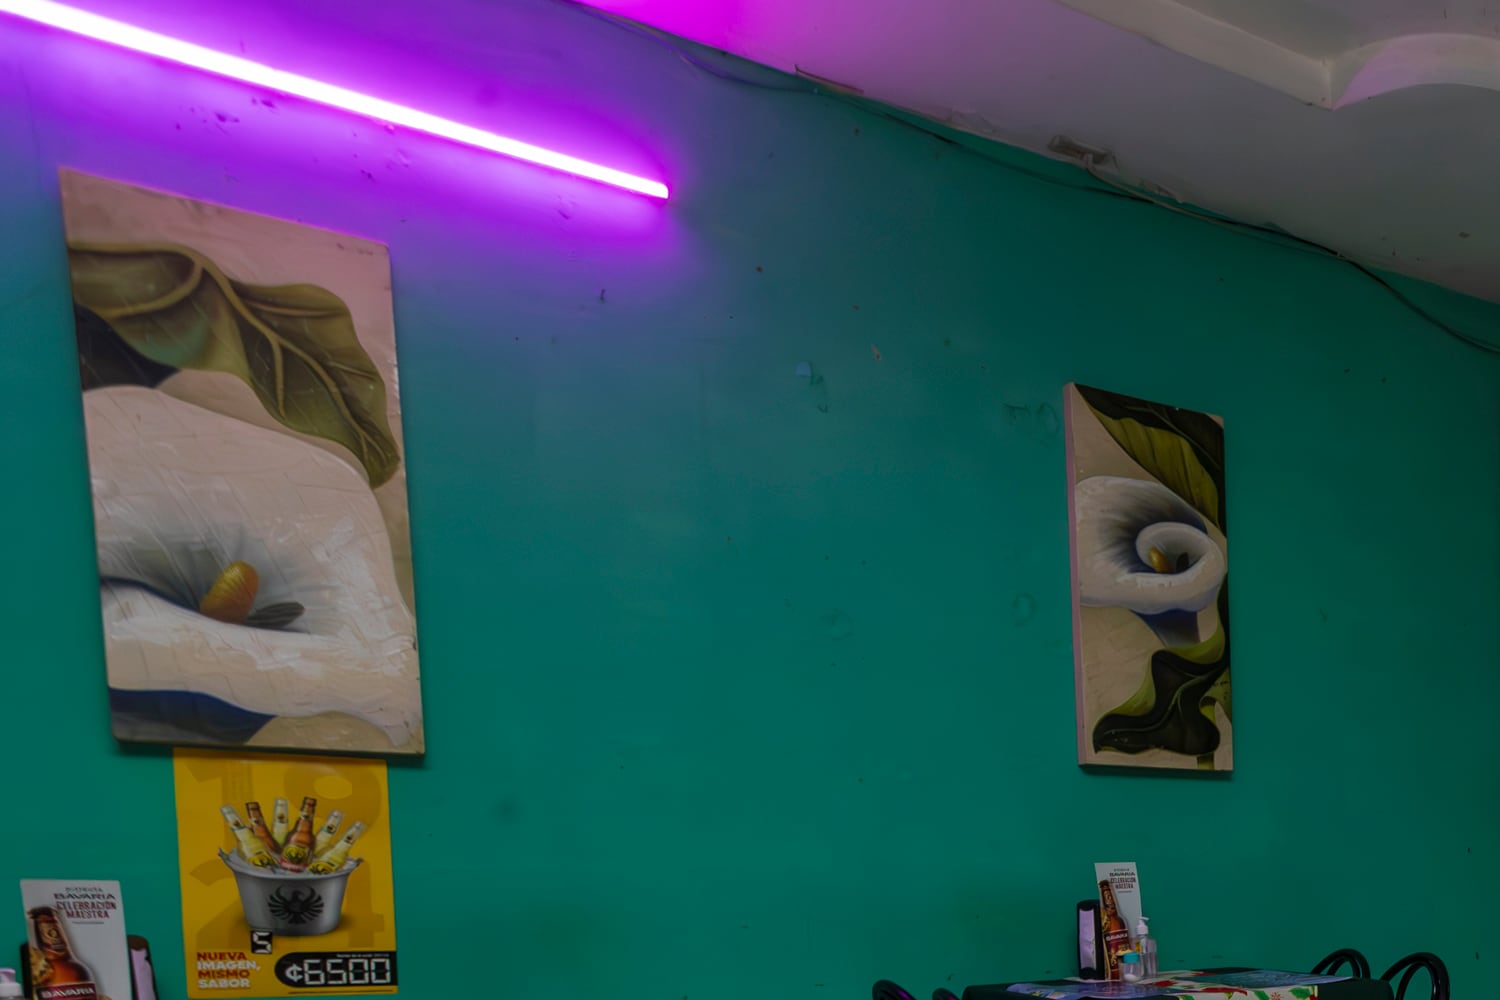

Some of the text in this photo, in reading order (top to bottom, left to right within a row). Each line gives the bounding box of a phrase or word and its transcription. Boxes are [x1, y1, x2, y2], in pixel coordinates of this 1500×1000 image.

[66, 910, 110, 919] MAESTRA
[253, 931, 272, 954] 5
[197, 952, 247, 961] NUEVA
[197, 960, 261, 971] IMAGEN,
[198, 969, 250, 979] MISMO
[198, 978, 250, 989] SABOR
